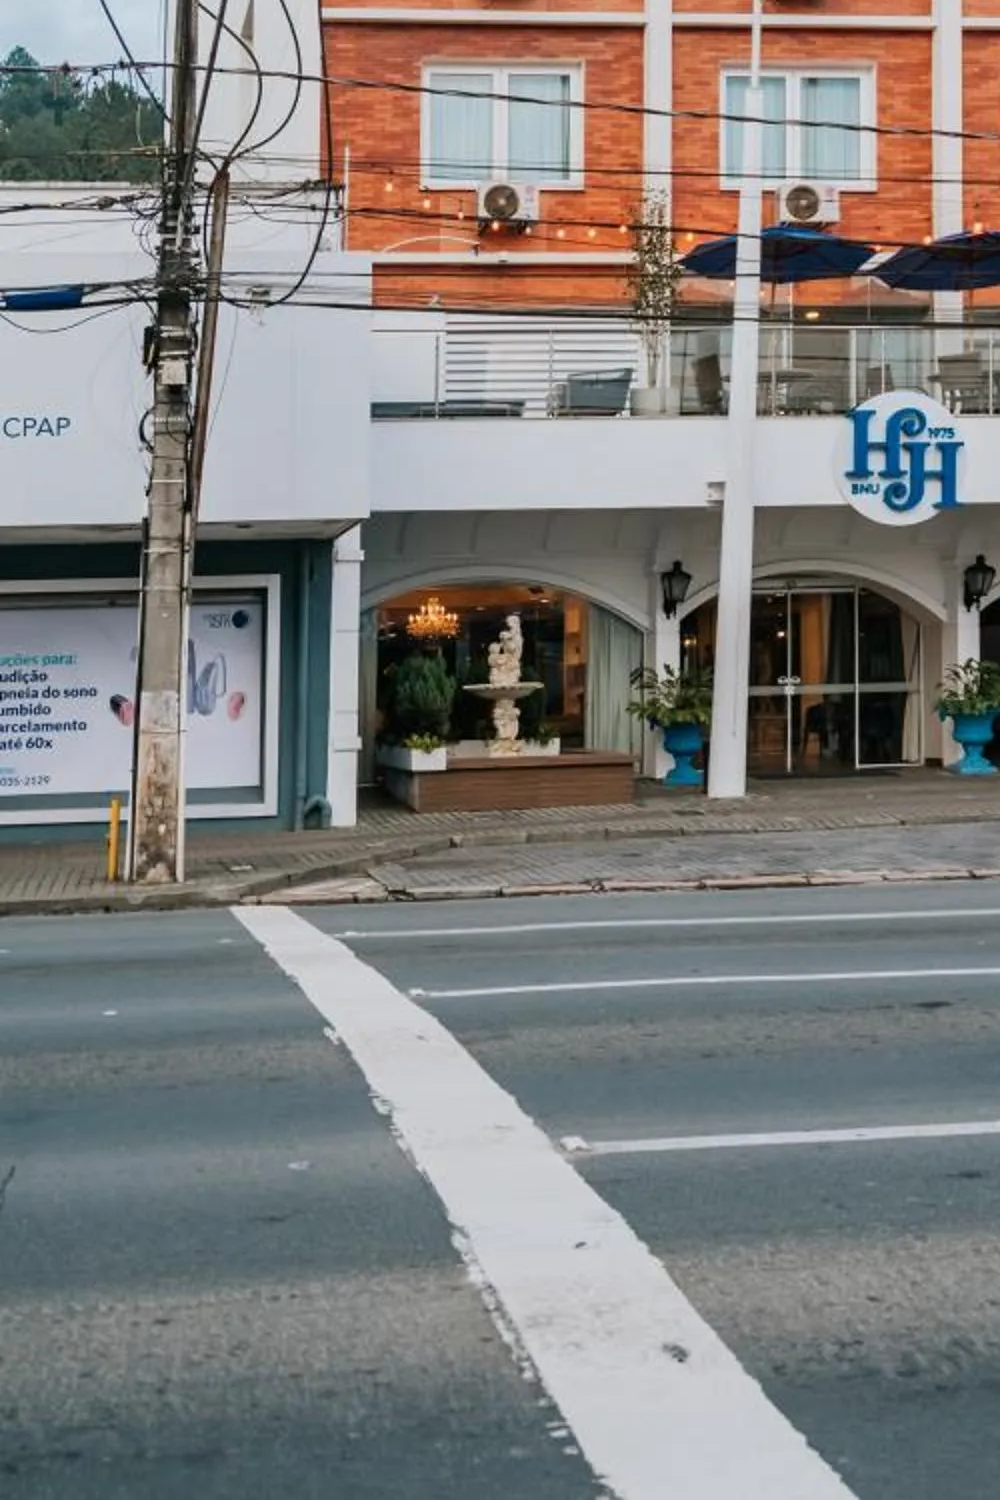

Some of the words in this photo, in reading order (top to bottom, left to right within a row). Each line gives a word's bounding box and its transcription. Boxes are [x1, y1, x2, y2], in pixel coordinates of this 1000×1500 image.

[3, 417, 71, 438] CPAP
[928, 427, 955, 439] 1975
[41, 685, 60, 699] do
[63, 687, 98, 699] sono
[25, 737, 53, 749] 60x
